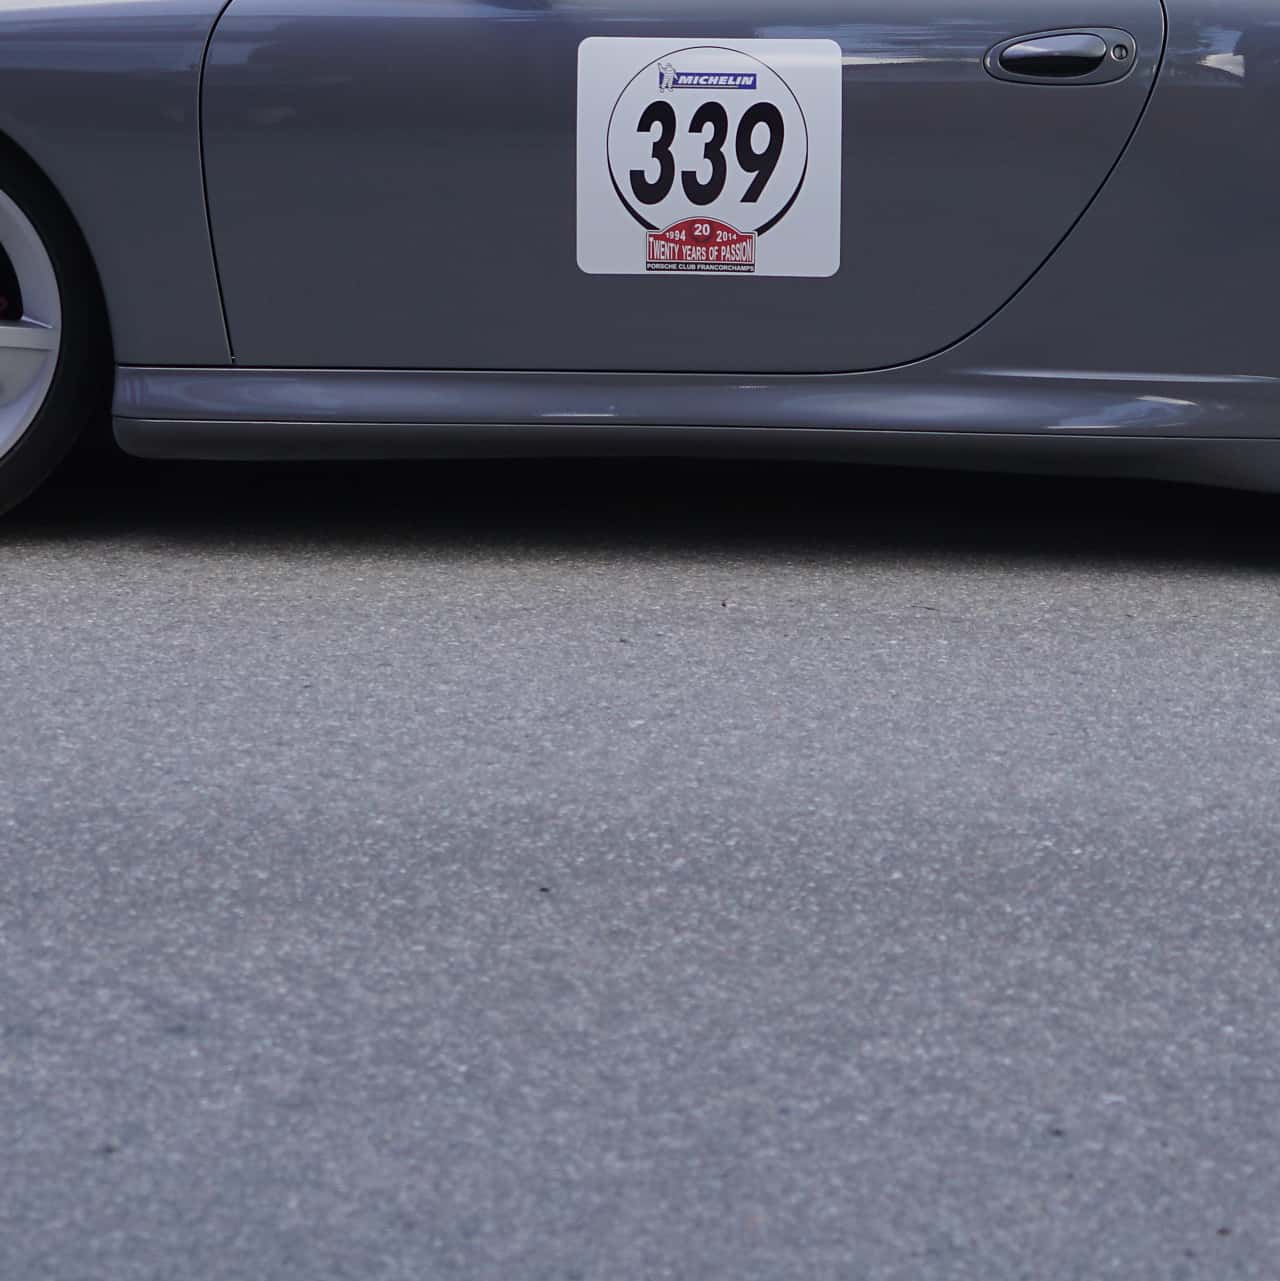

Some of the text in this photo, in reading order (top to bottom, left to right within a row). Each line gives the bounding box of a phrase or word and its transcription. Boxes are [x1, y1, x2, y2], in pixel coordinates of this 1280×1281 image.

[678, 75, 754, 85] MICHELIN
[629, 100, 785, 205] 339
[666, 223, 737, 242] 1994 20 2014
[648, 237, 752, 261] TWENTY YEARS OF PASSION
